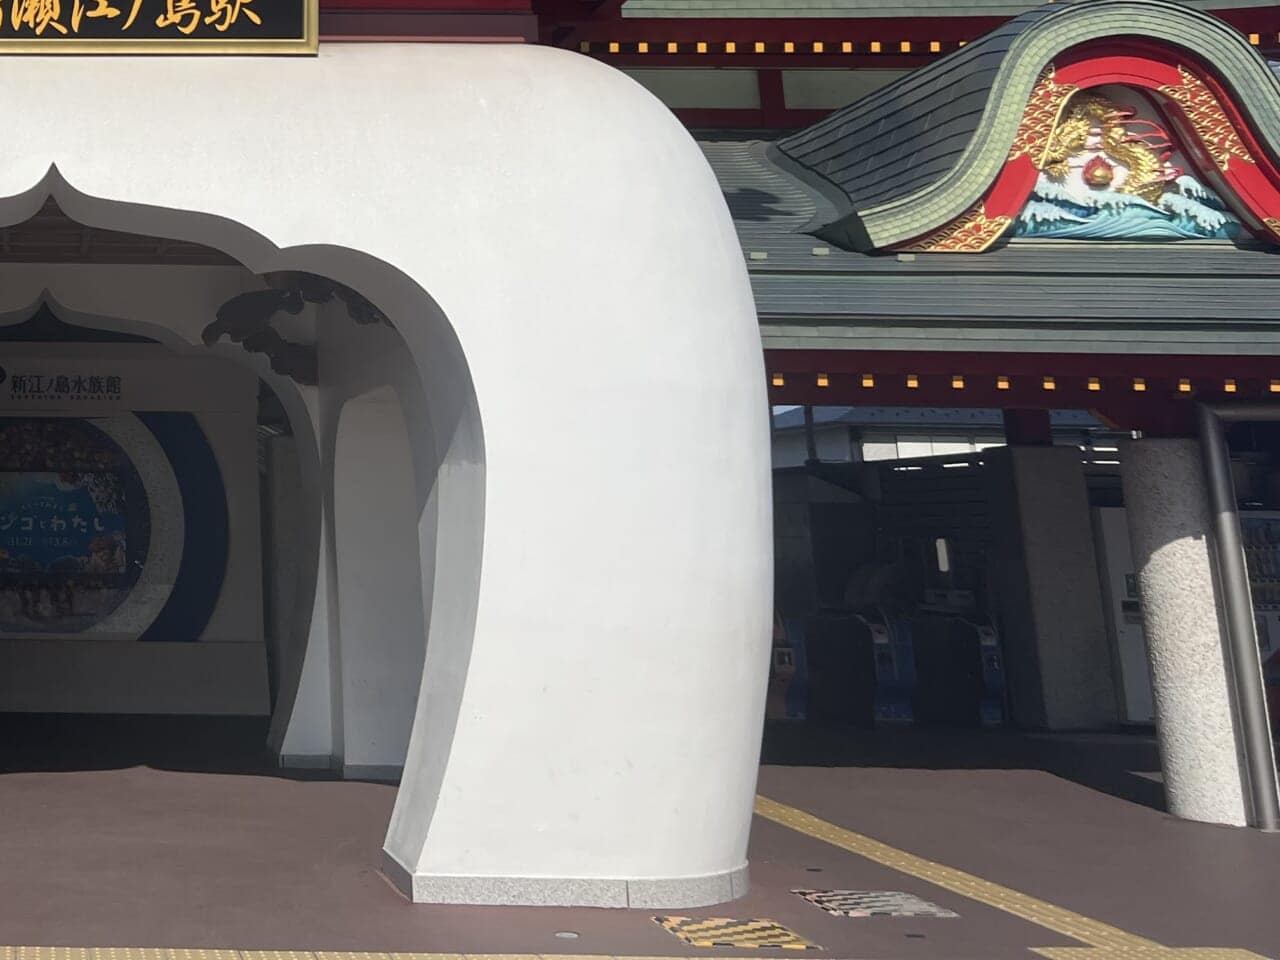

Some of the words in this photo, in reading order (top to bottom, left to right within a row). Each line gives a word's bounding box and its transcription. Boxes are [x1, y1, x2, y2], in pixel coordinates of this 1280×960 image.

[10, 375, 121, 394] 新江ノ島水族館
